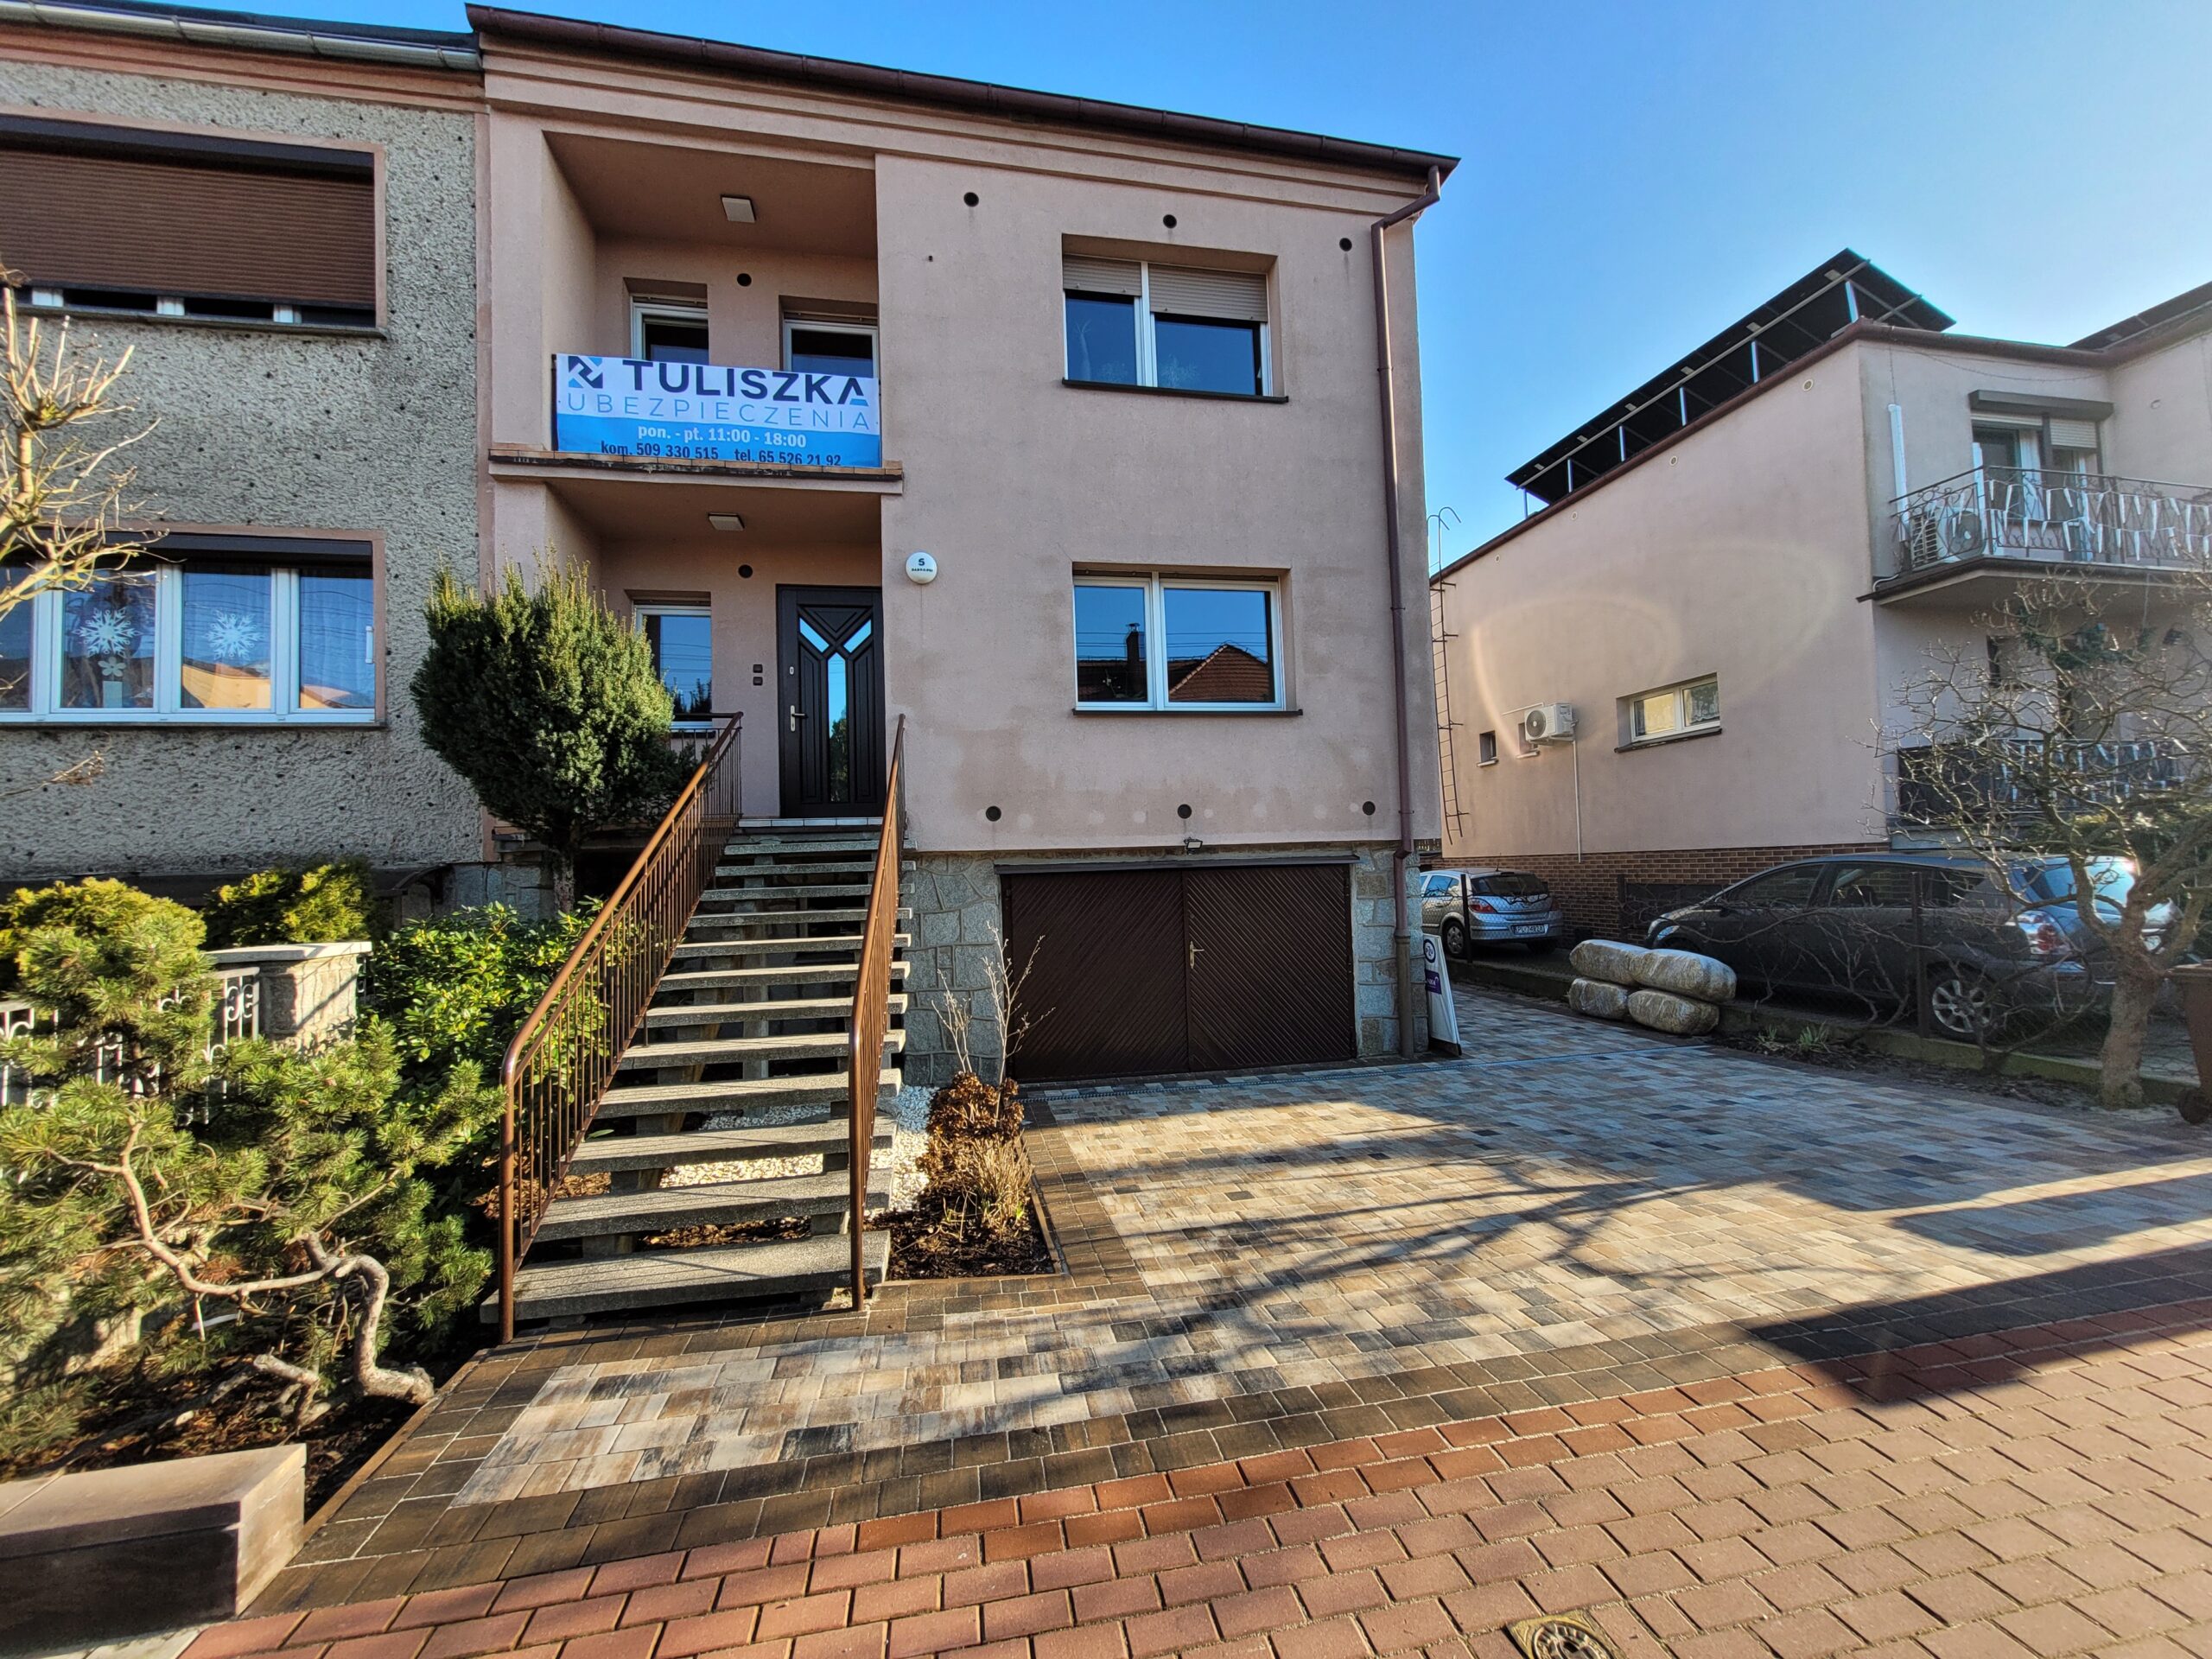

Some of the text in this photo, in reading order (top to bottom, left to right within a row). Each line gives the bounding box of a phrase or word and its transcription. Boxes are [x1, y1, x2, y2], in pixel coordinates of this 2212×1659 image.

[623, 359, 868, 406] TULISZKA
[568, 393, 869, 429] UBEZPIECZENIA
[638, 426, 671, 439] pon.
[684, 427, 703, 443] pt.
[709, 428, 751, 443] 11:00
[764, 432, 807, 448] 18:00
[601, 441, 841, 466] kom. 509 330 515 tel. 65 526 21 92
